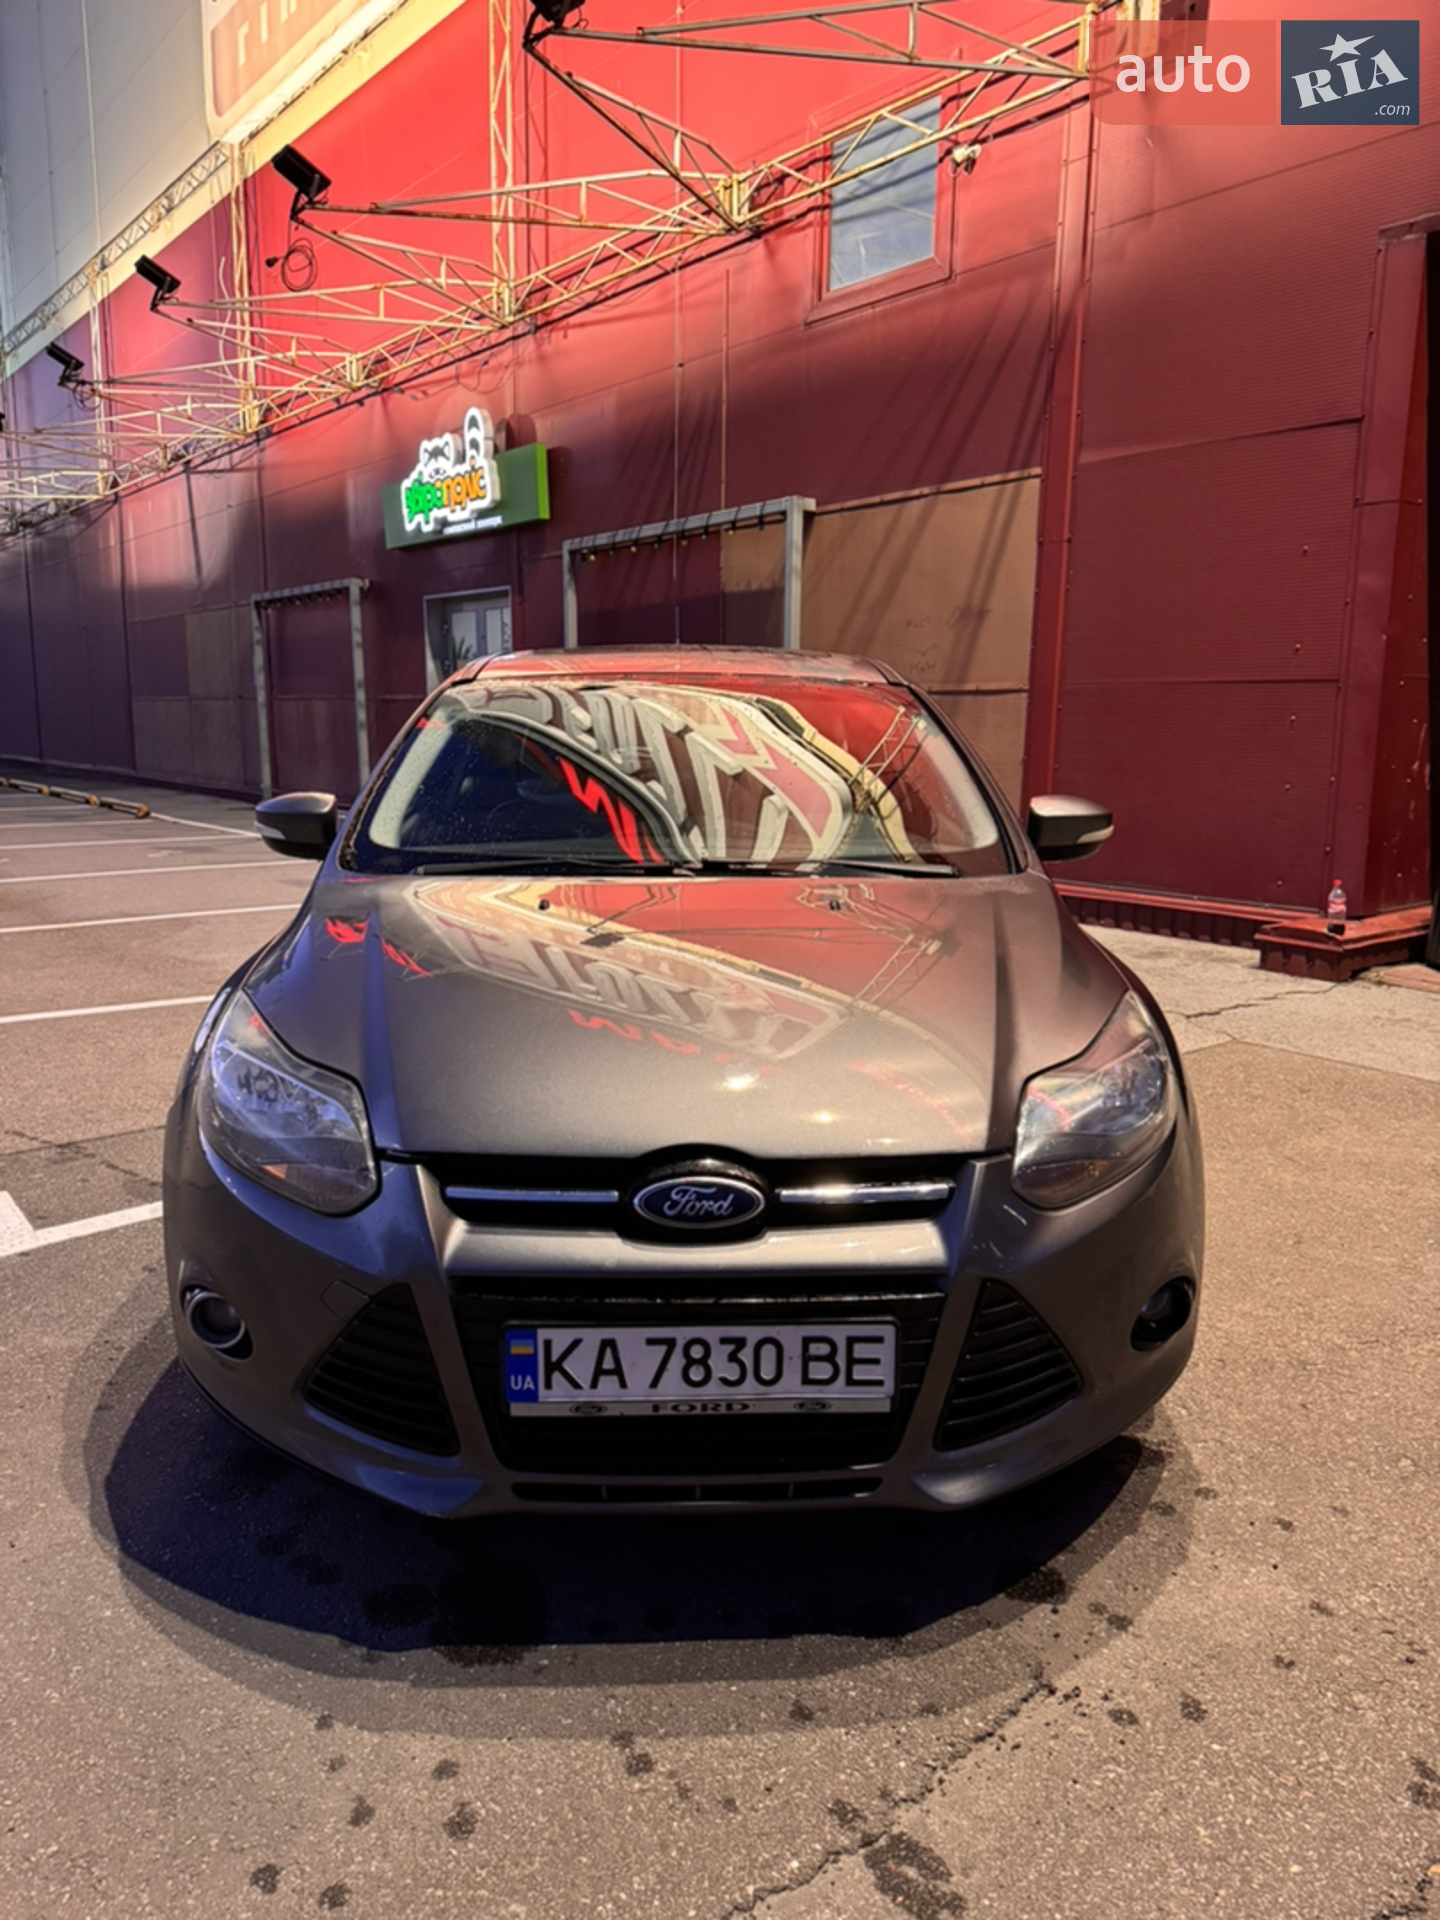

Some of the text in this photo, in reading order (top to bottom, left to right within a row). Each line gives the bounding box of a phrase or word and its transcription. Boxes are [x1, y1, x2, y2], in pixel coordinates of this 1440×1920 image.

[663, 1185, 735, 1216] Ford
[543, 1335, 885, 1390] KA 7830 BE
[510, 1374, 535, 1391] UA
[652, 1402, 749, 1414] FORD
